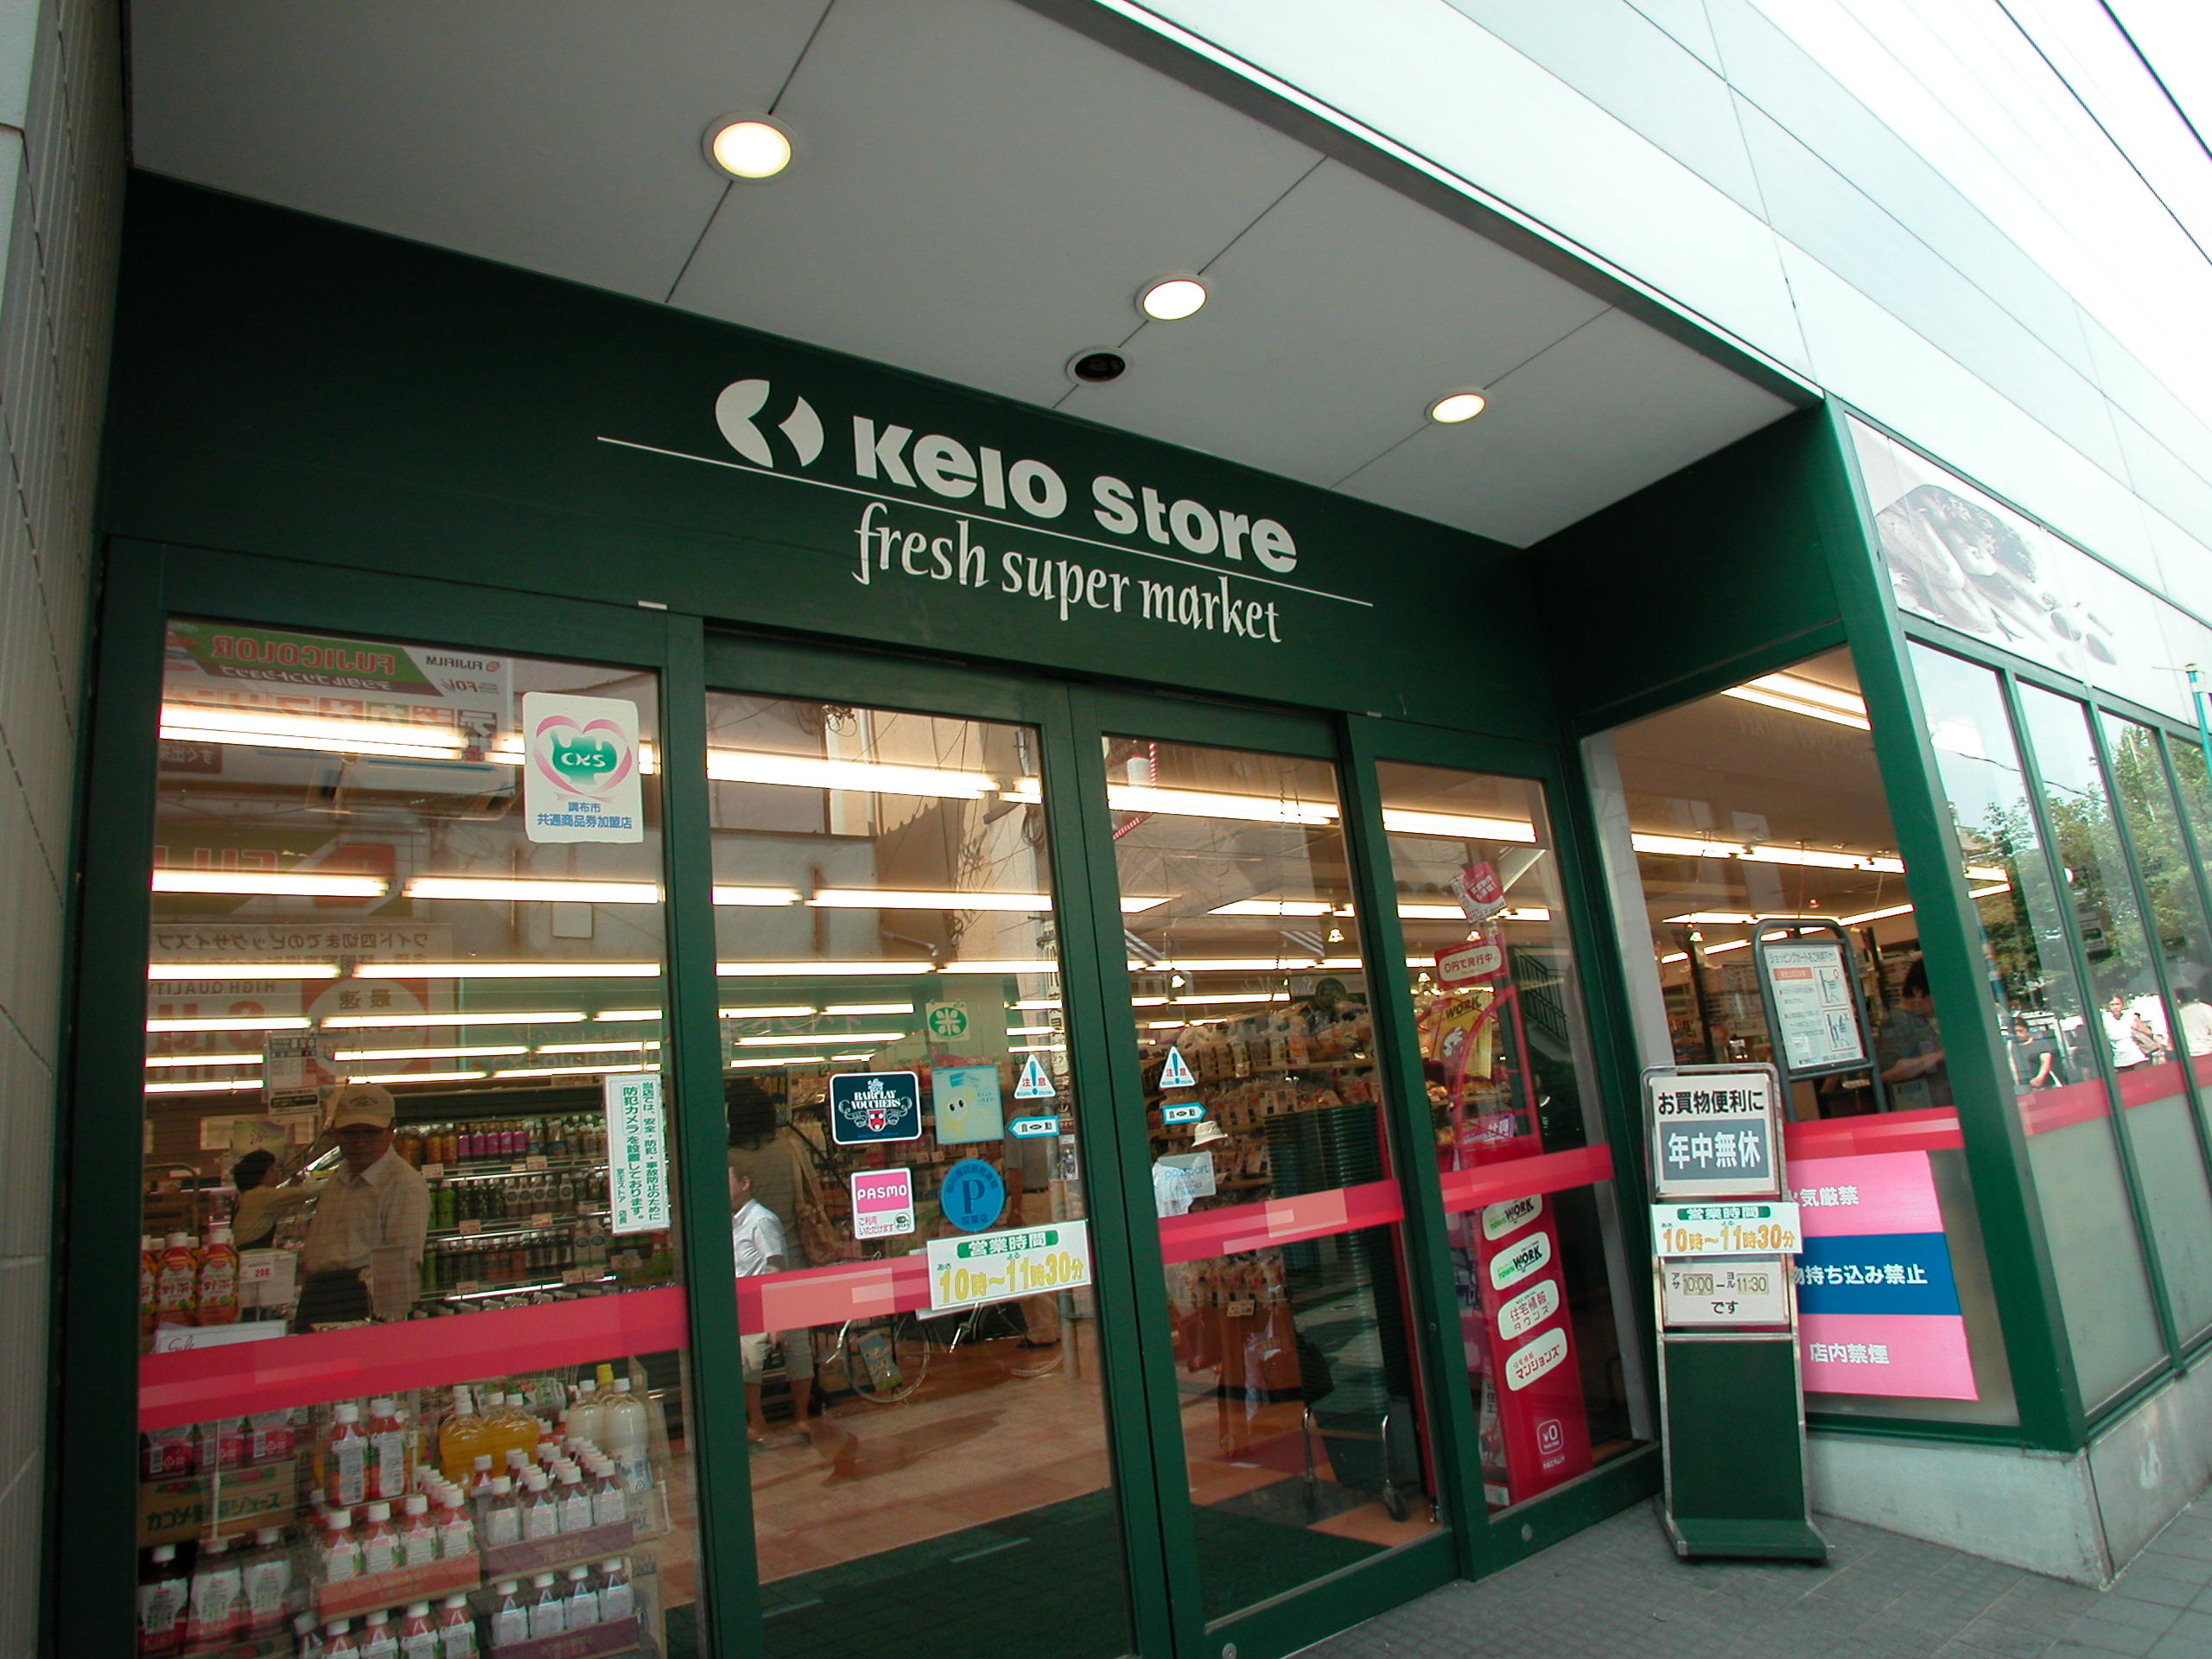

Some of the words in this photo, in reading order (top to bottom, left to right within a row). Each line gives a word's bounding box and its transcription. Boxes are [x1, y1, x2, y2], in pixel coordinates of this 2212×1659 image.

[1092, 475, 1298, 573] store
[852, 502, 990, 584] fresh
[1002, 550, 1131, 620] super
[1141, 576, 1282, 643] market
[568, 802, 601, 813] 調布市
[537, 812, 632, 830] 共通商品券加盟店
[851, 1098, 901, 1109] VOUCHERS
[854, 1090, 897, 1101] BARCLAY
[1658, 1090, 1764, 1116] お買物便利に
[1669, 1130, 1761, 1170] 年中無休
[857, 1185, 907, 1200] PASMO
[961, 1179, 985, 1214] P
[1789, 1185, 1859, 1207] 気厳禁
[1504, 1198, 1535, 1220] WORK
[1687, 1206, 1759, 1219] 営業時間
[969, 1233, 1046, 1256] 営業時間
[1513, 1244, 1542, 1269] WORK
[1737, 1277, 1766, 1292] 11:30
[1711, 1300, 1738, 1313] です
[1516, 1344, 1560, 1379] マンションズ
[1809, 1343, 1890, 1364] 店内禁煙
